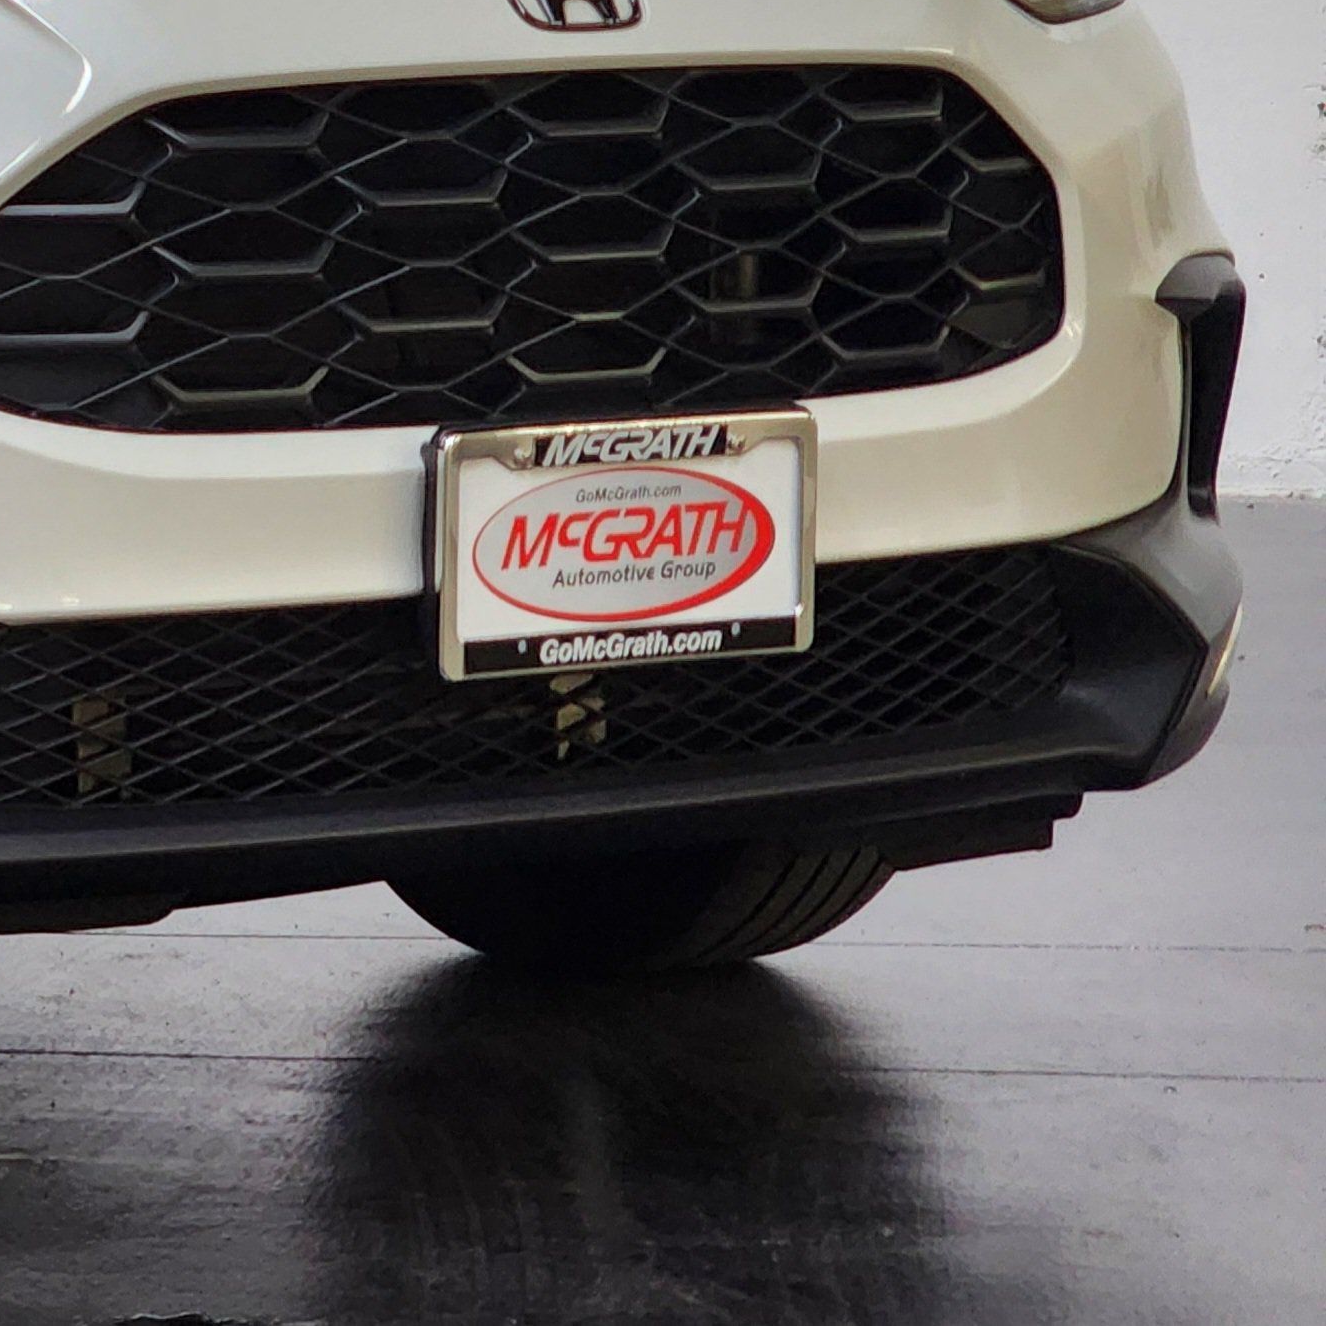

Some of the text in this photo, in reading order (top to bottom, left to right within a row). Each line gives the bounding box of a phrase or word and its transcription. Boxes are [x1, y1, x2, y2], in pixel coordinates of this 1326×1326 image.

[575, 483, 682, 504] GoMcGrath.com
[551, 560, 716, 590] Automotive Group
[539, 628, 723, 665] GoMcGrath.com
